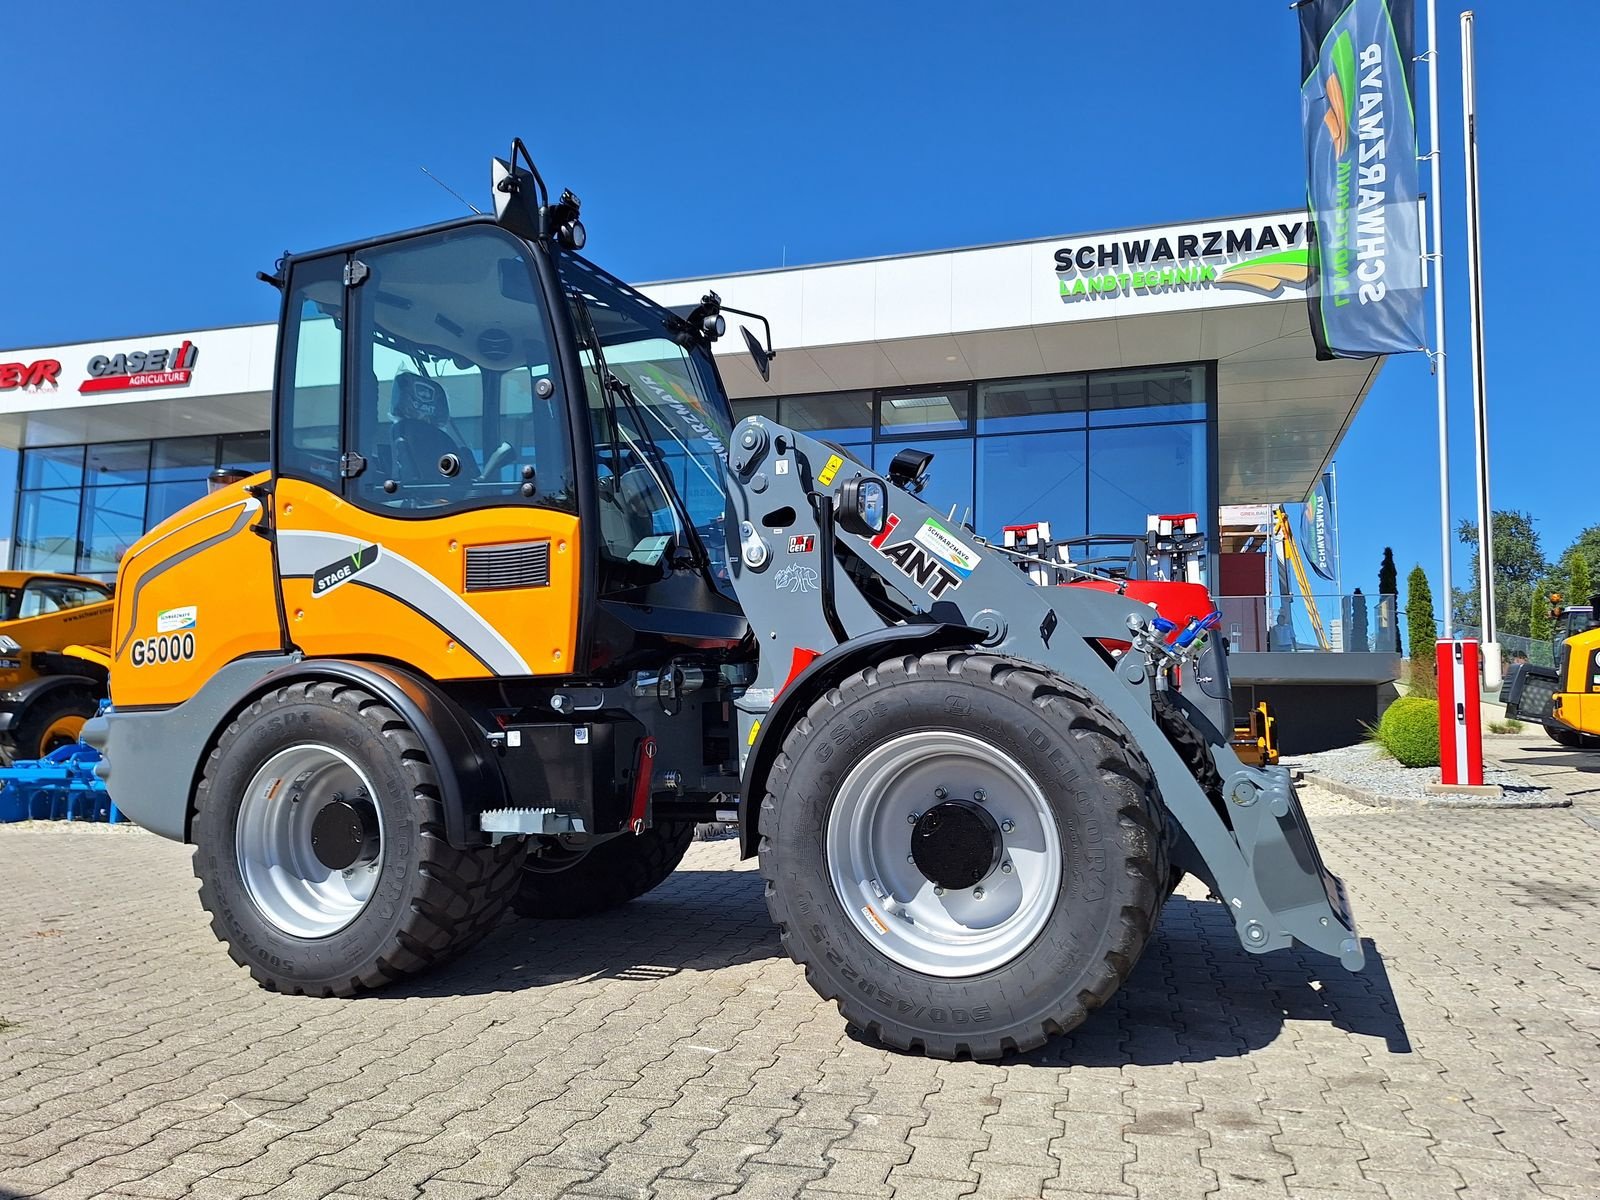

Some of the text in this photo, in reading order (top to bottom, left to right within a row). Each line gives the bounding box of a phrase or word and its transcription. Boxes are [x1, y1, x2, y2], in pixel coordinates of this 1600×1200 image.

[1059, 264, 1217, 298] LANDTECHNIK
[87, 348, 169, 377] CASE
[128, 371, 186, 386] AGRICULTURE
[927, 526, 970, 561] SCHWARZMAYR
[317, 565, 352, 590] STAGE
[131, 632, 195, 667] G5000
